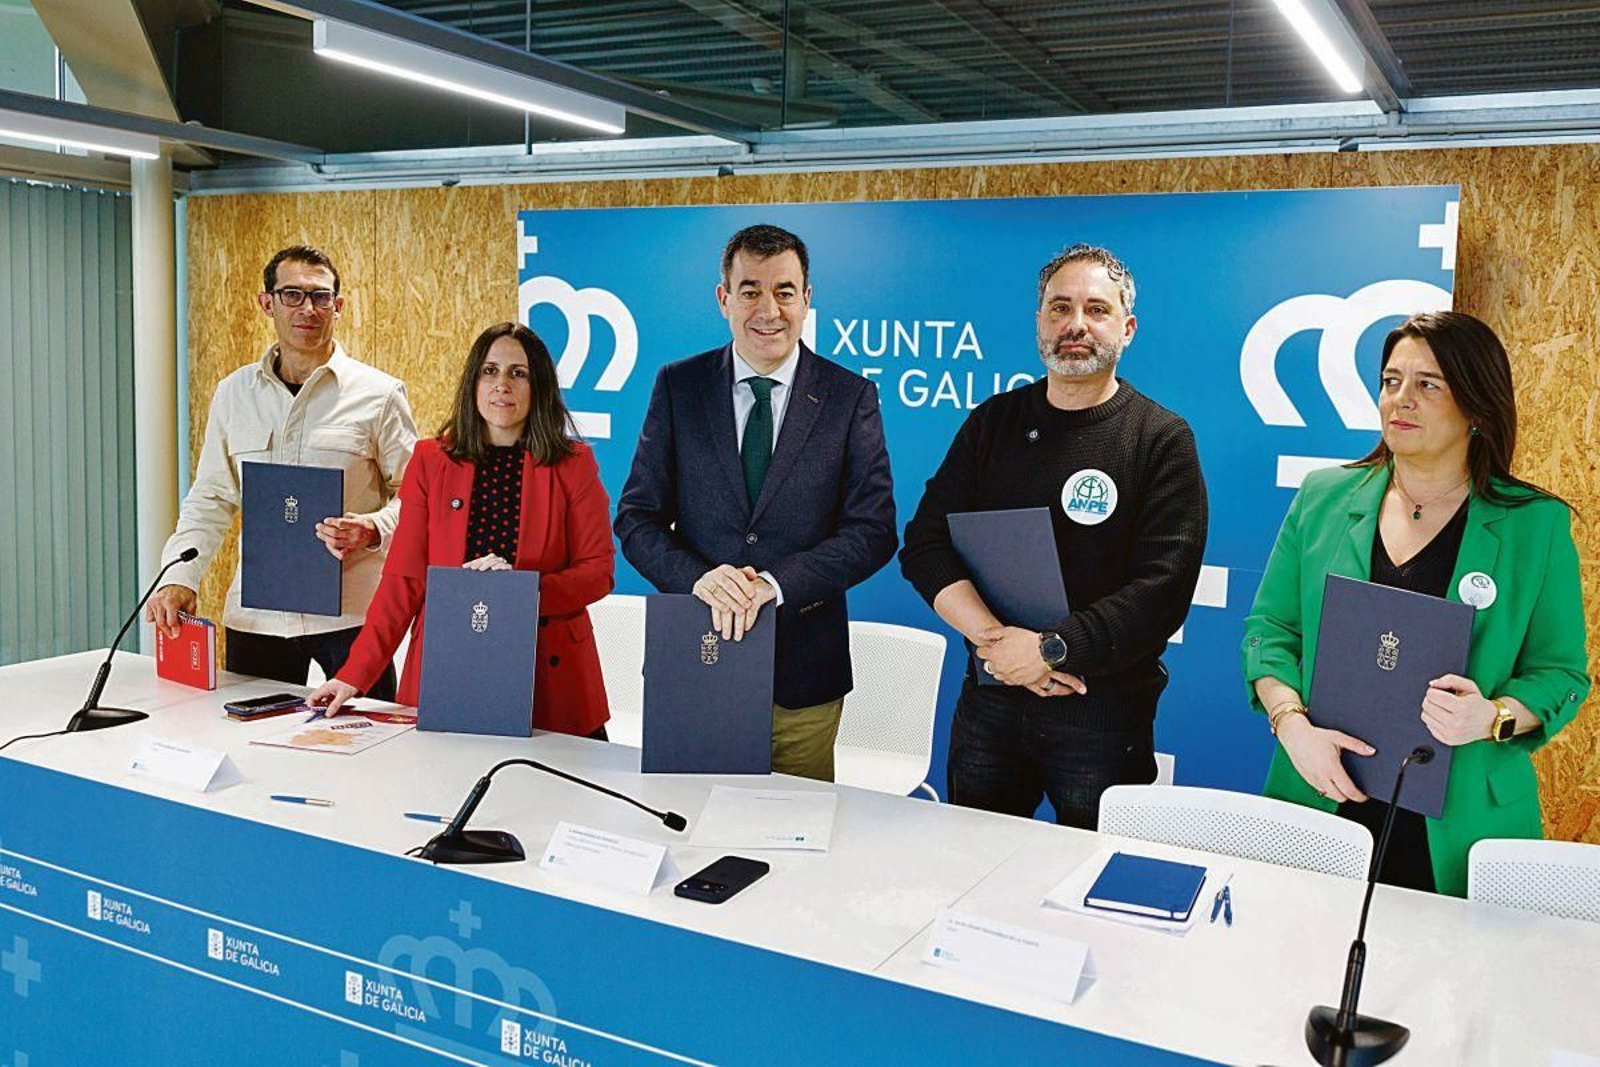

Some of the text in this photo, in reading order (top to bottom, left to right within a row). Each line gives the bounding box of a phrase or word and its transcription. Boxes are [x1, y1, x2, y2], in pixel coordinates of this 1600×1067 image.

[832, 318, 984, 361] XUNTA
[1067, 498, 1109, 513] ANPE
[0, 863, 22, 880] UNTA
[6, 878, 38, 897] GALICIA
[103, 897, 133, 917] XUNTA
[103, 909, 151, 935] DE GALICIA
[225, 936, 260, 957] XUNTA
[225, 948, 280, 976] DE GALICIA
[365, 979, 404, 1002] XUNTA
[364, 993, 427, 1023] DE GALICIA
[523, 1043, 540, 1060] DE
[524, 1028, 568, 1054] XUNTA
